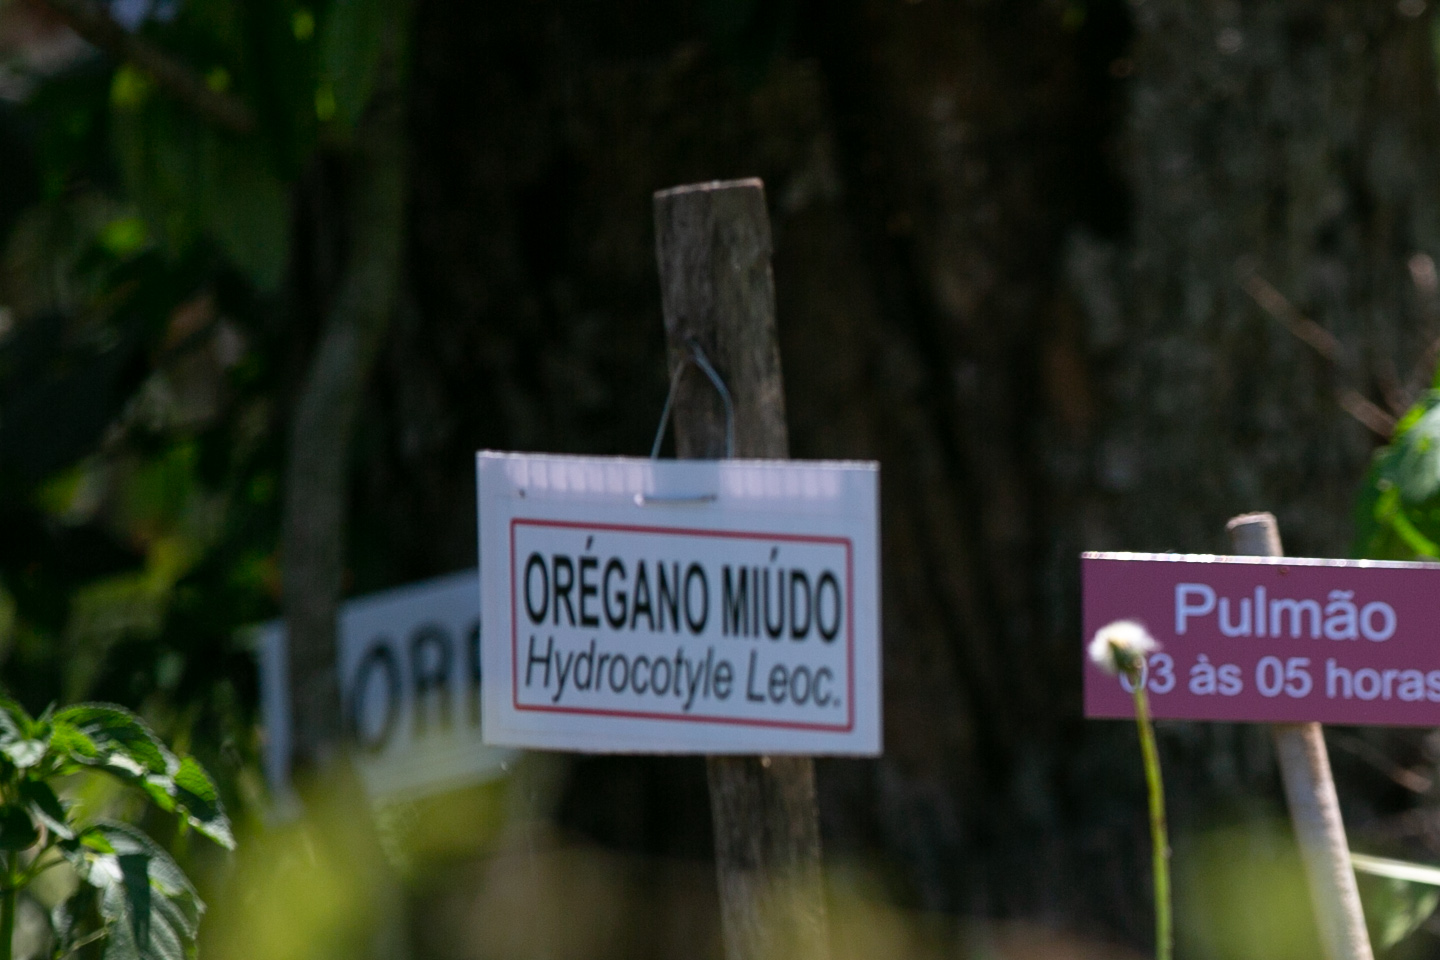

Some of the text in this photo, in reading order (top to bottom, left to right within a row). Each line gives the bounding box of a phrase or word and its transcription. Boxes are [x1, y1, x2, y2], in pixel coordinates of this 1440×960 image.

[523, 536, 842, 643] ORÉGANO MIÚDO
[1174, 582, 1398, 642] Pulmão
[525, 635, 841, 712] Hydrocotyle Leoc.
[1189, 655, 1244, 697] às
[1255, 656, 1314, 699] 05
